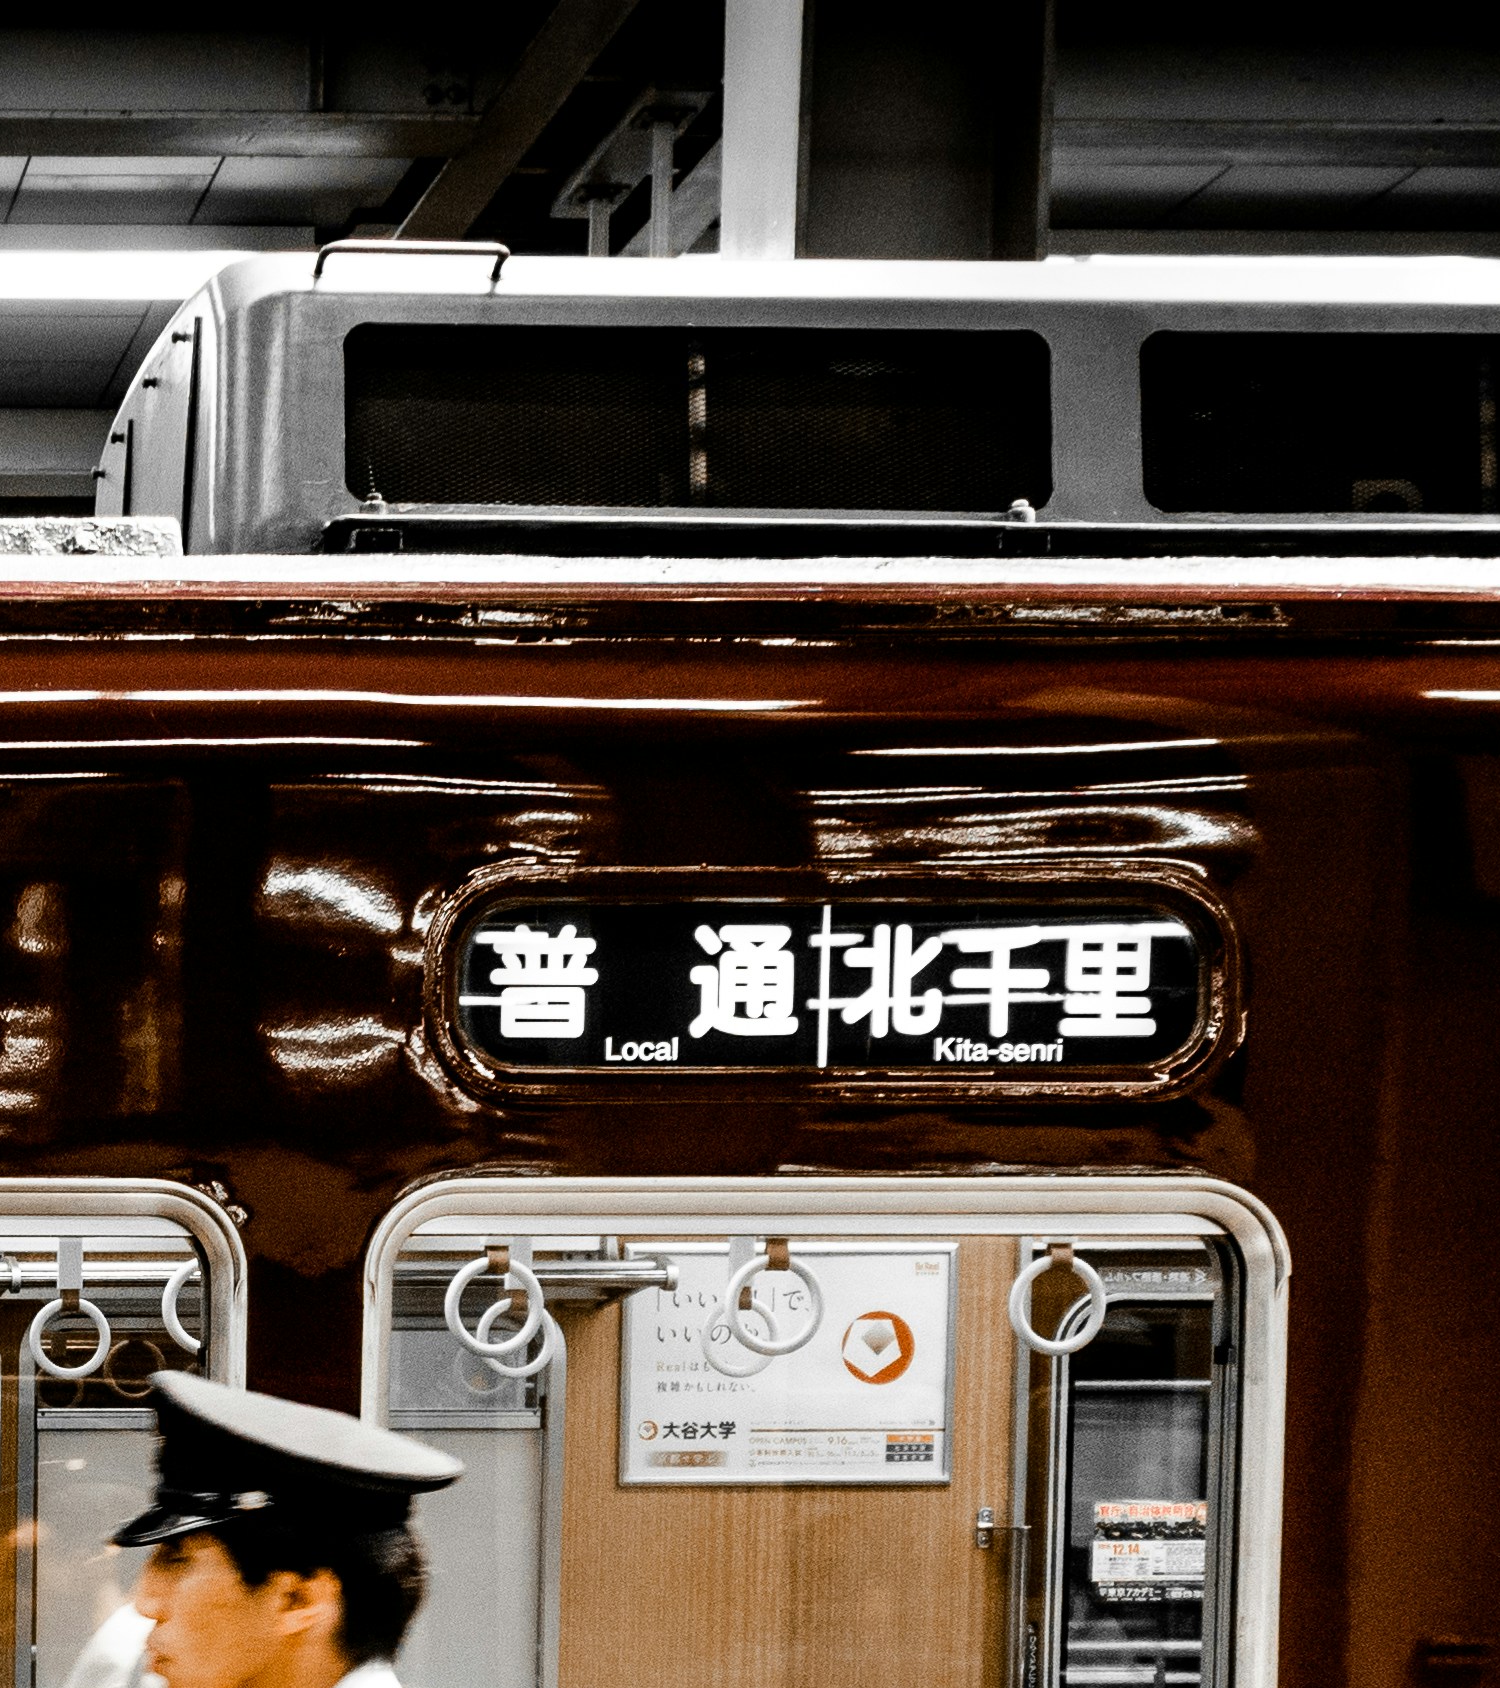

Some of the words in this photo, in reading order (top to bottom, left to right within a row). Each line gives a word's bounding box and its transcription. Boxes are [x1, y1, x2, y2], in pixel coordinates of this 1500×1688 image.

[489, 923, 798, 1039] 普通
[843, 923, 1157, 1039] 北千里
[604, 1037, 679, 1062] Local
[933, 1036, 1064, 1062] Kita-senri
[662, 1421, 736, 1440] 大谷大学
[1112, 1543, 1140, 1556] 12.14
